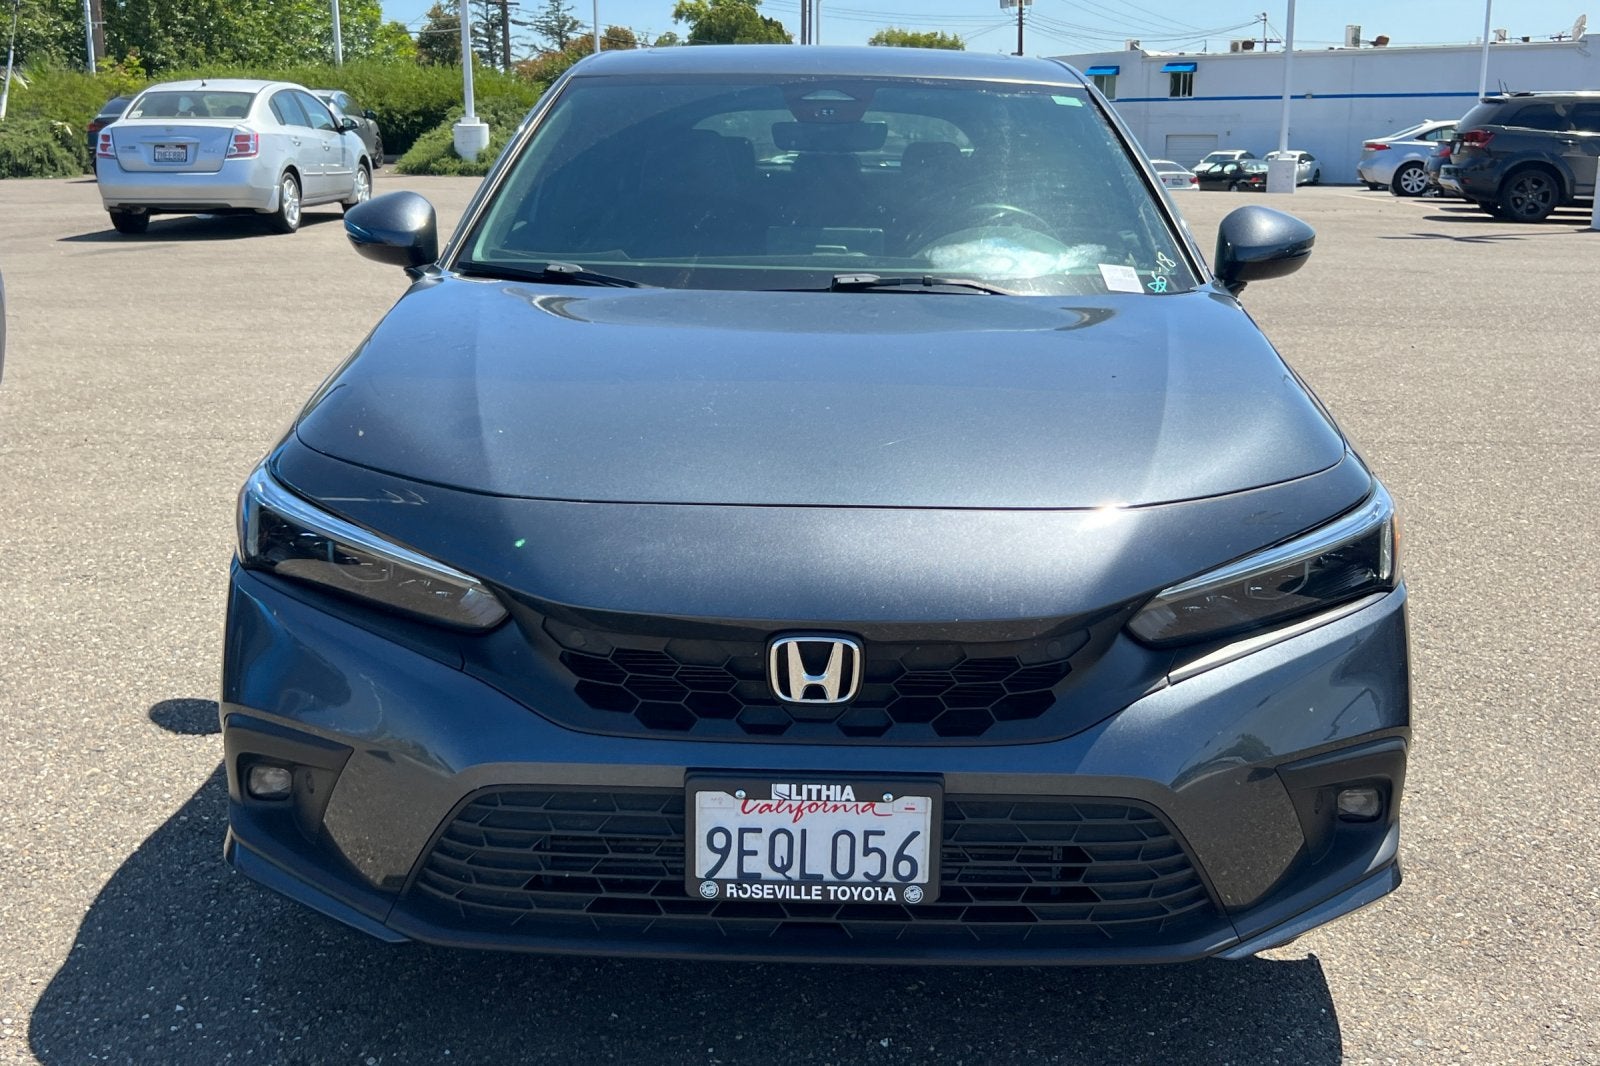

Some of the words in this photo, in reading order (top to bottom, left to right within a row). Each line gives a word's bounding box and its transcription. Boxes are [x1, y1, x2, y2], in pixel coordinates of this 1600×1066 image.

[790, 784, 856, 802] LITHIA
[705, 826, 921, 882] 9EQL056
[726, 883, 822, 900] ROSEVILLE
[827, 886, 897, 902] TOYOTA
